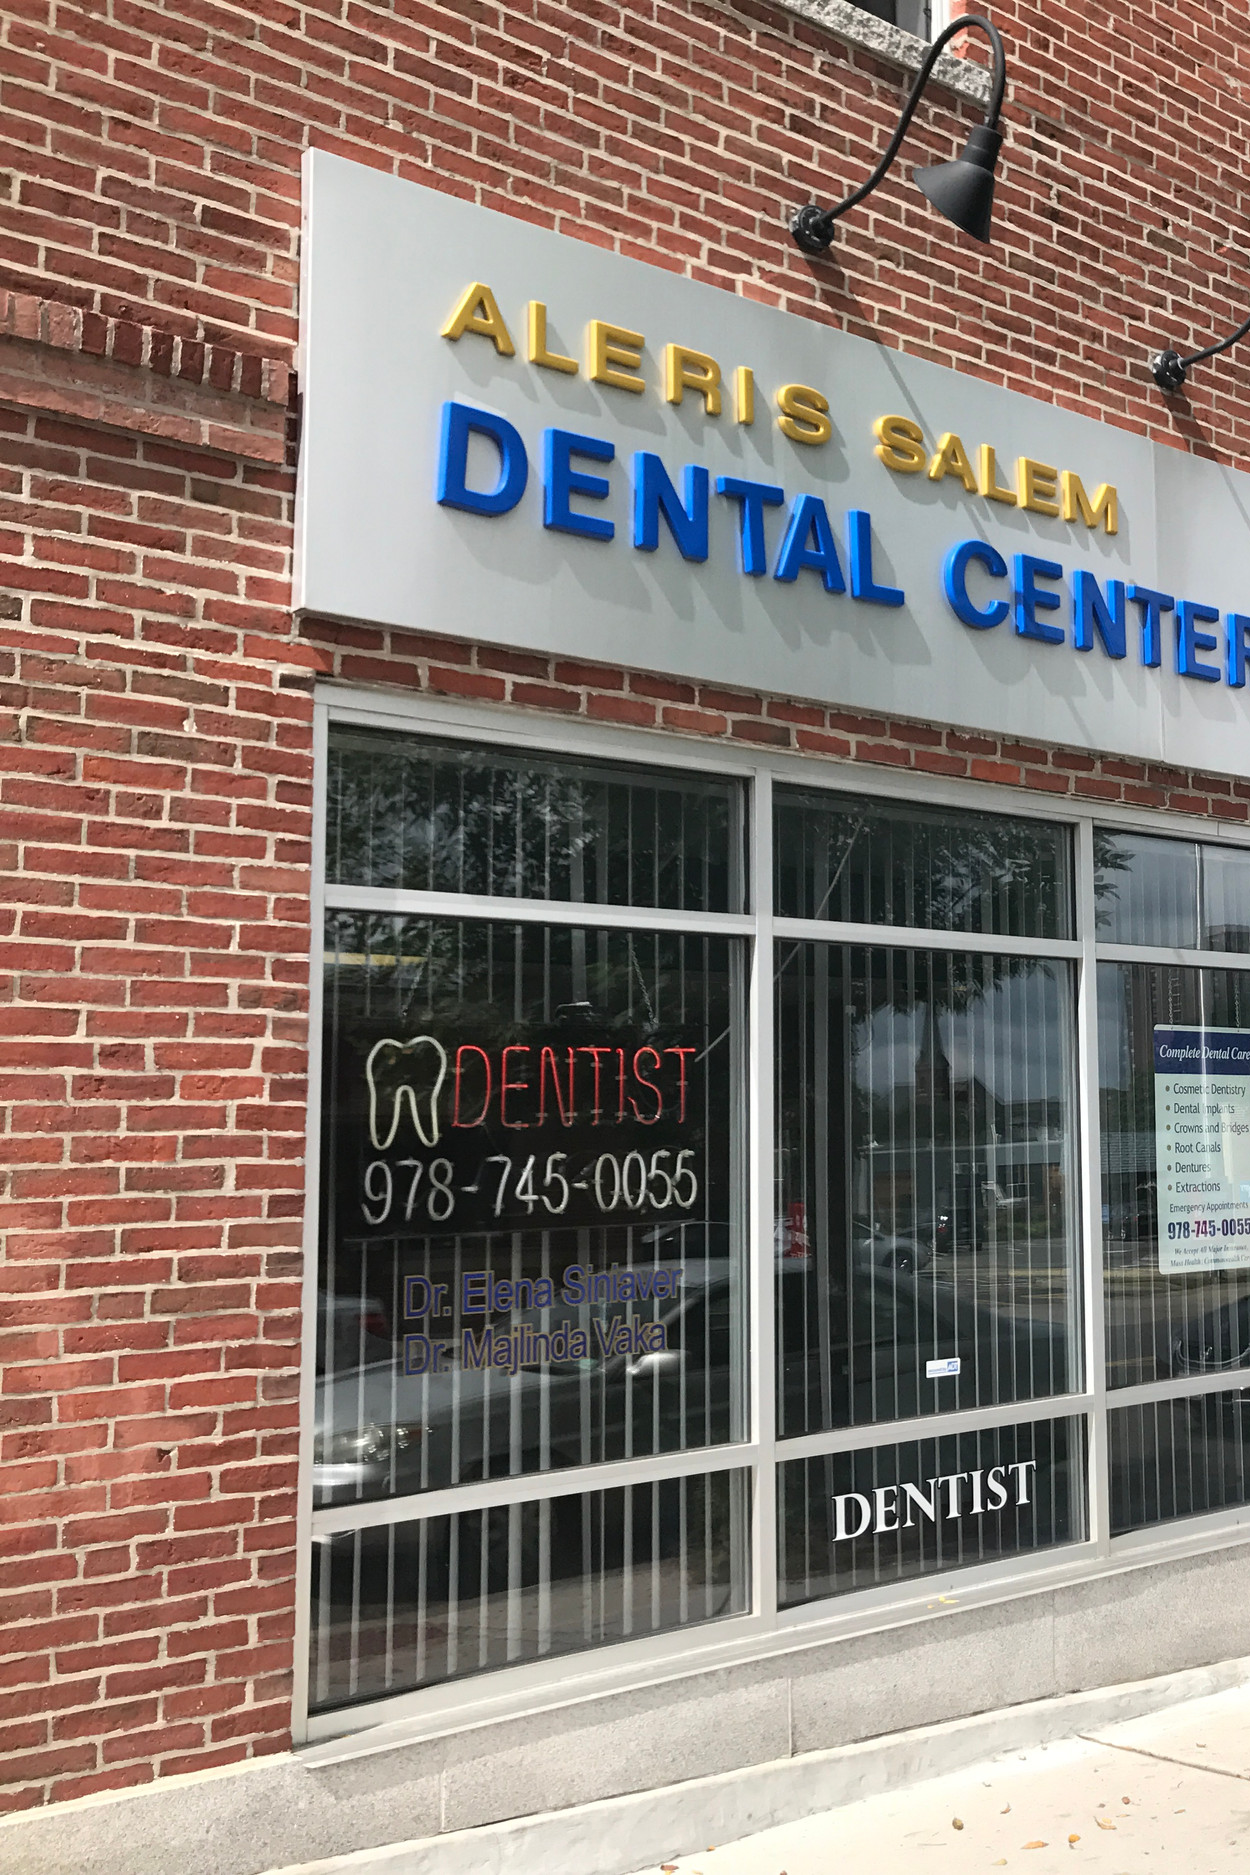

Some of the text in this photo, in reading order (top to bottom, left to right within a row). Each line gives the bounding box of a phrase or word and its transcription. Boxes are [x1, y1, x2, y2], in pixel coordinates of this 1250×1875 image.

[441, 281, 1119, 535] ALERIS SALEM
[437, 400, 905, 607] DENTAL
[1159, 1044, 1250, 1061] Complete Dental Care
[452, 1045, 696, 1128] DENTIST
[1173, 1083, 1246, 1097] Cosmetc Dentistry
[1174, 1103, 1235, 1116] Dental mplants
[1174, 1122, 1249, 1135] Crowns and Bridges
[1175, 1141, 1221, 1153] Root Canals
[1175, 1162, 1211, 1173] Dentures
[362, 1150, 698, 1225] 978-745-0055
[1175, 1182, 1221, 1193] Extractions
[1170, 1201, 1248, 1214] Emergency Appointments
[404, 1262, 684, 1320] Dr. Elena Siniaver
[404, 1313, 668, 1377] Dr. Majlinda Vaka
[832, 1459, 1036, 1542] DENTIST
